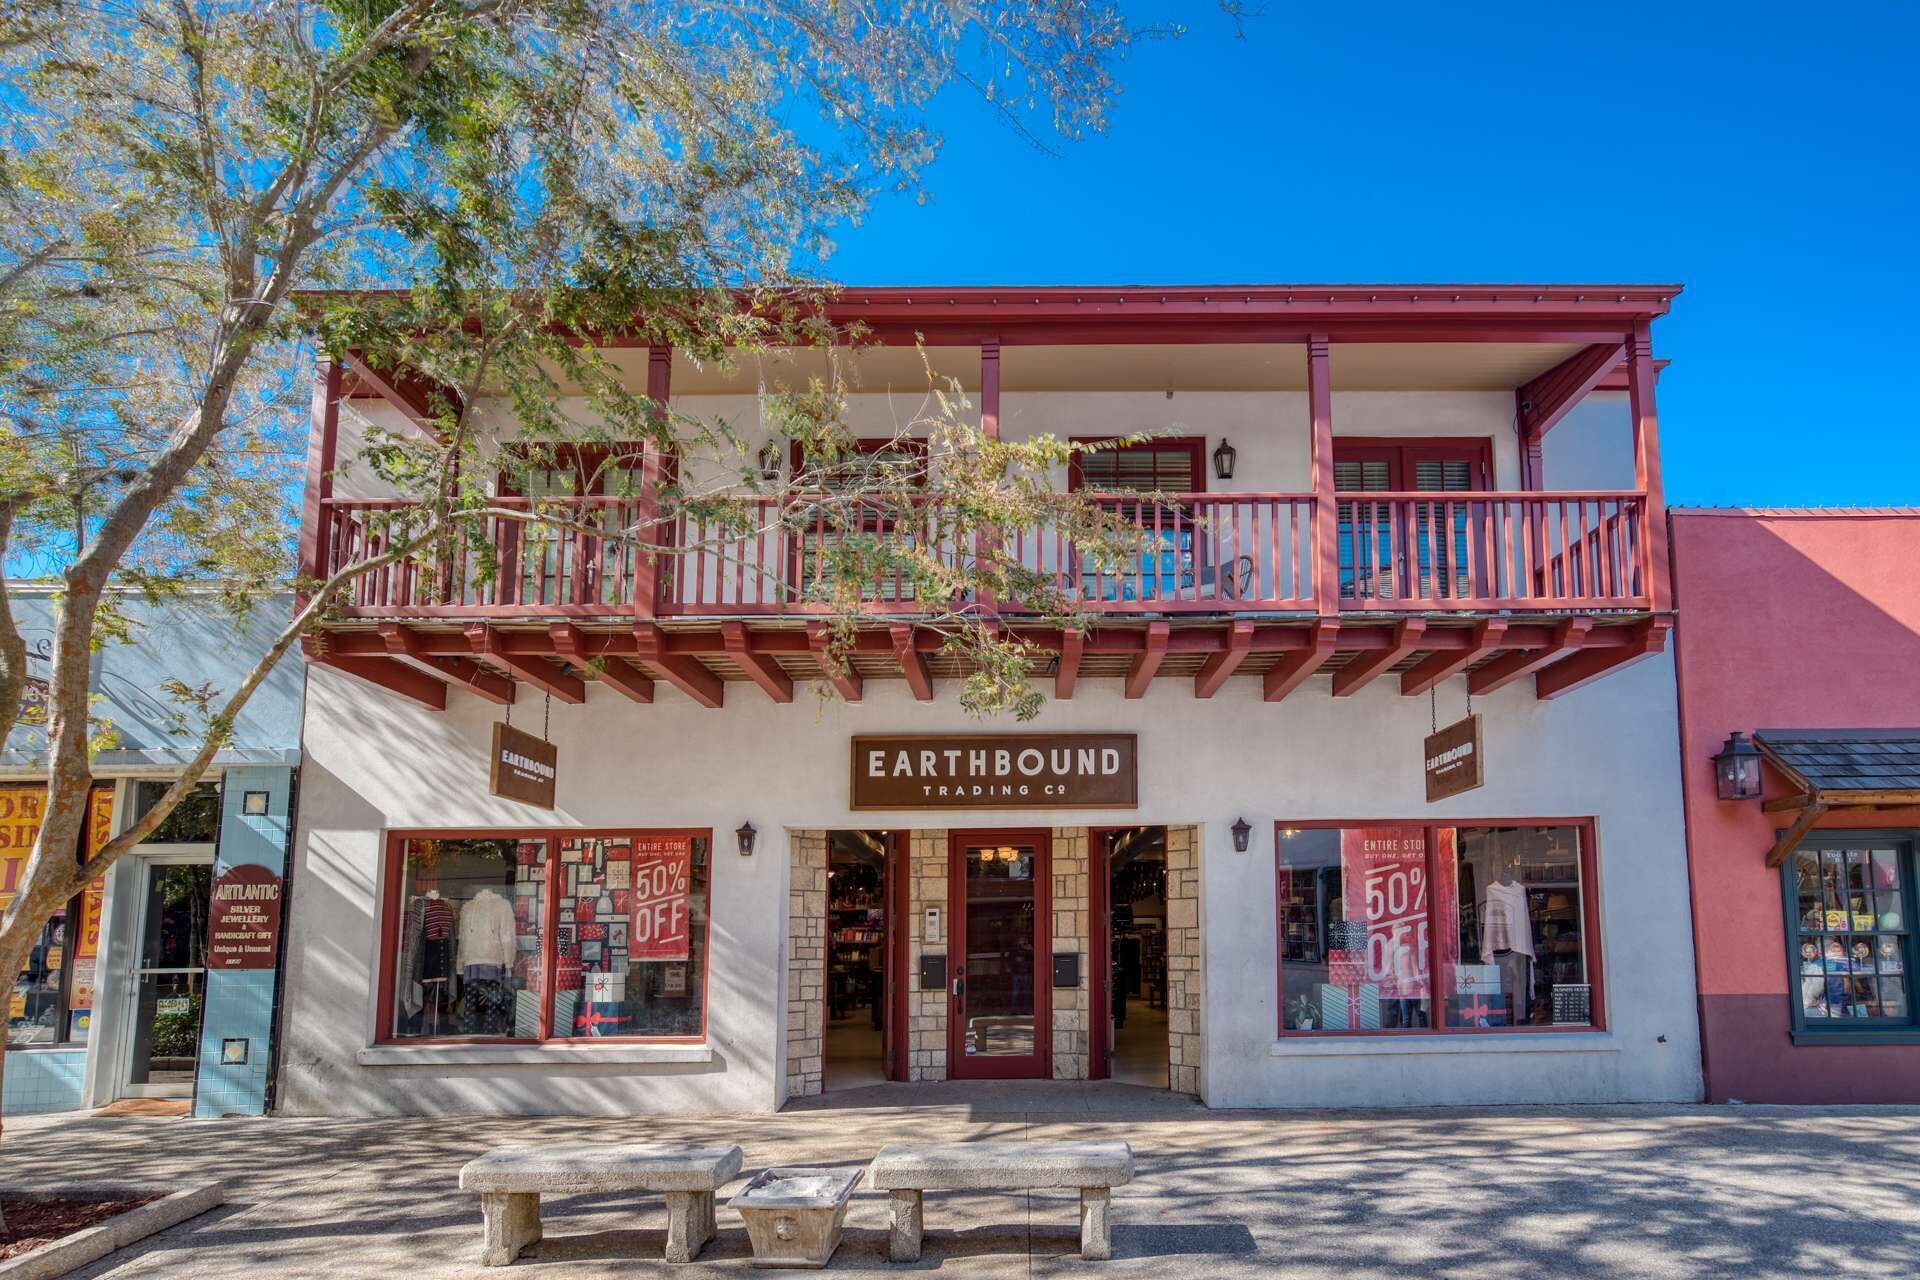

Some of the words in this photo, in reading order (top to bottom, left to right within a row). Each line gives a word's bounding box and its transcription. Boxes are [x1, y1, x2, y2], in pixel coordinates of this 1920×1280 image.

[869, 748, 1120, 777] EARTHBOUND
[1426, 742, 1473, 771] EARTHBOUND
[501, 749, 555, 779] EARTHBOUND
[923, 785, 1030, 797] TRADING
[637, 842, 662, 852] ENTIRE
[665, 841, 686, 851] STORE
[1364, 839, 1398, 851] ENTIRE
[1403, 839, 1425, 851] STO
[636, 860, 686, 900] 50%
[215, 884, 280, 901] ARTLANTIC
[230, 905, 262, 914] SILVER
[220, 915, 270, 924] JEWELLERY
[636, 899, 686, 943] OFF
[214, 932, 256, 940] HANDICRAFT
[213, 945, 238, 954] Unique
[244, 945, 271, 953] Unusual
